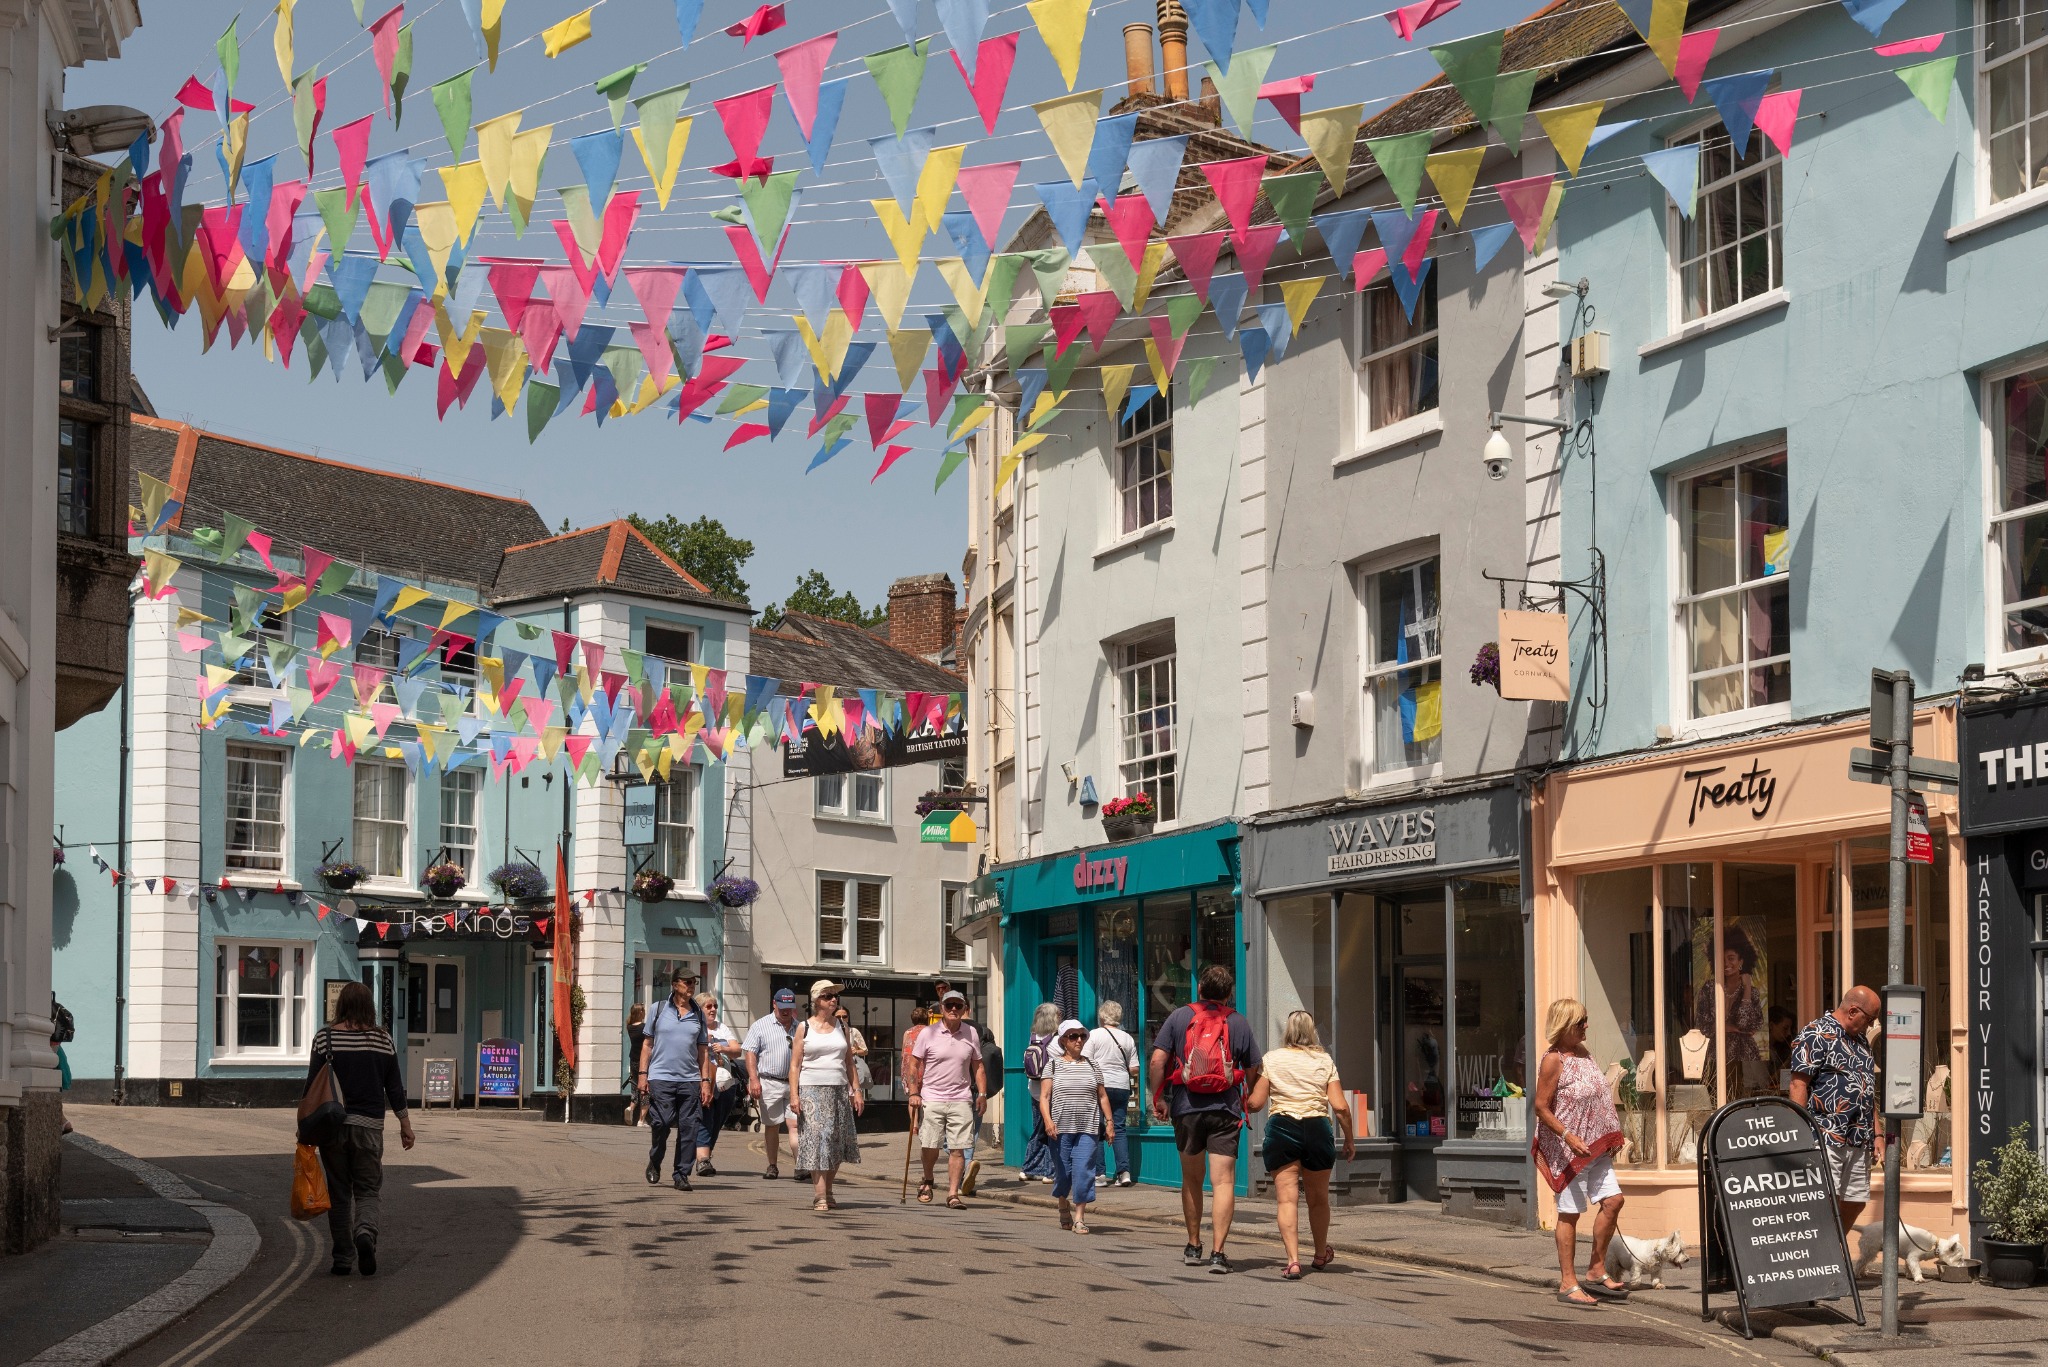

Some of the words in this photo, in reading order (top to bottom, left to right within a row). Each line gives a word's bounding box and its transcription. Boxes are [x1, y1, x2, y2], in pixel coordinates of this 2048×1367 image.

[1511, 638, 1559, 665] Treaty
[1513, 669, 1557, 679] CORNWALL
[906, 741, 934, 753] BRITISH
[934, 738, 961, 749] TATTOO
[1979, 741, 2048, 786] THE
[1684, 758, 1777, 826] Treaty
[922, 825, 949, 836] Miller
[1328, 809, 1436, 852] WAVES
[1331, 844, 1433, 870] HAIRDRESSING
[1073, 852, 1128, 891] dizzy
[396, 909, 447, 933] The
[1978, 854, 1991, 1011] HARBOUR
[482, 1048, 518, 1056] COCKTAIL
[1977, 1023, 1994, 1135] VIEWS
[1460, 1096, 1502, 1112] Hairdressing
[1745, 1116, 1776, 1131] THE
[1727, 1129, 1799, 1150] LOOKOUT
[1724, 1167, 1823, 1195] GARDEN
[1730, 1195, 1787, 1211] HARBOUR
[1788, 1190, 1826, 1203] VIEWS
[1752, 1214, 1784, 1227] OPEN
[1786, 1211, 1811, 1223] FOR
[1750, 1229, 1819, 1246] BREAKFAST
[1769, 1249, 1810, 1263] LUNCH
[1747, 1275, 1756, 1285] &
[1757, 1270, 1795, 1283] TAPAS
[1796, 1264, 1841, 1279] DINNER
